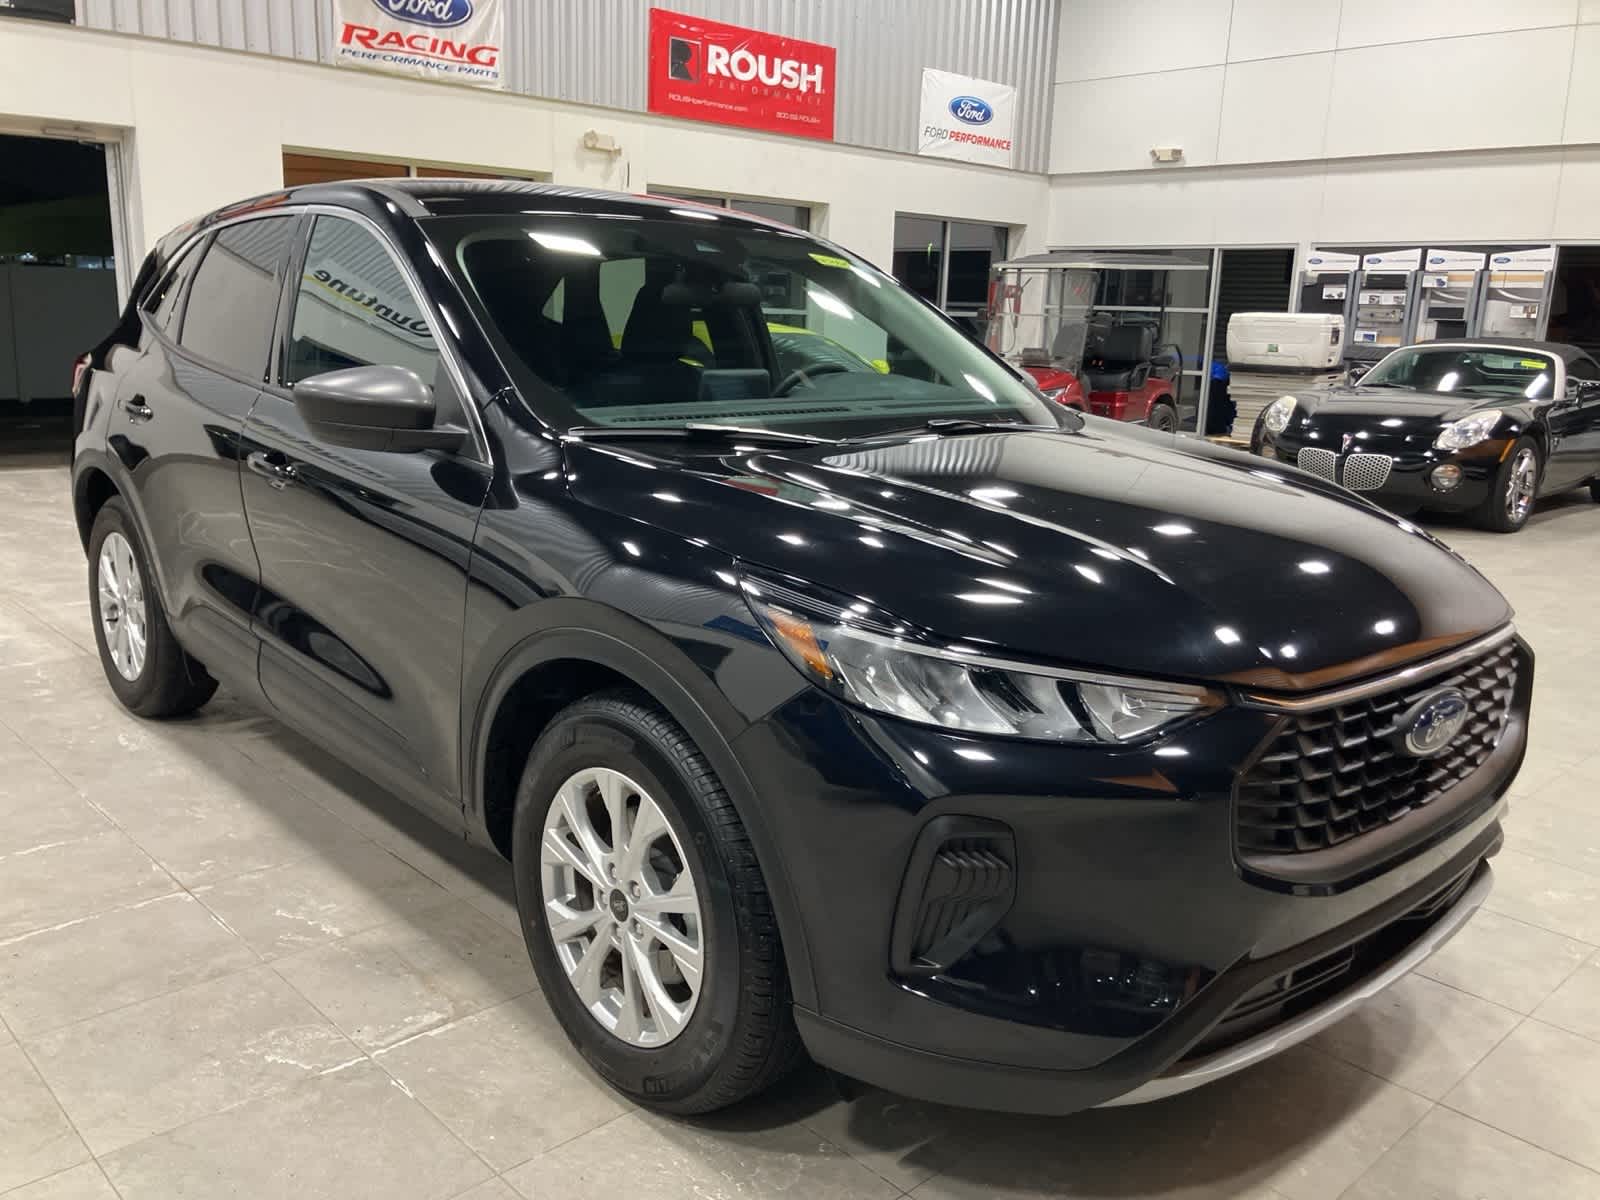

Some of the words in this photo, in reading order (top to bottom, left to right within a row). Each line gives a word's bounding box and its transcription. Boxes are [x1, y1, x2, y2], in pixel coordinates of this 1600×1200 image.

[341, 23, 499, 67] RACING
[341, 48, 454, 72] PERFORMANCE
[458, 67, 499, 79] PARTS
[707, 45, 823, 94] ROUSH
[708, 78, 821, 105] PERFORMANCE
[957, 99, 985, 121] Ford
[924, 126, 948, 139] FORD
[948, 130, 1012, 150] PERFORMANCE
